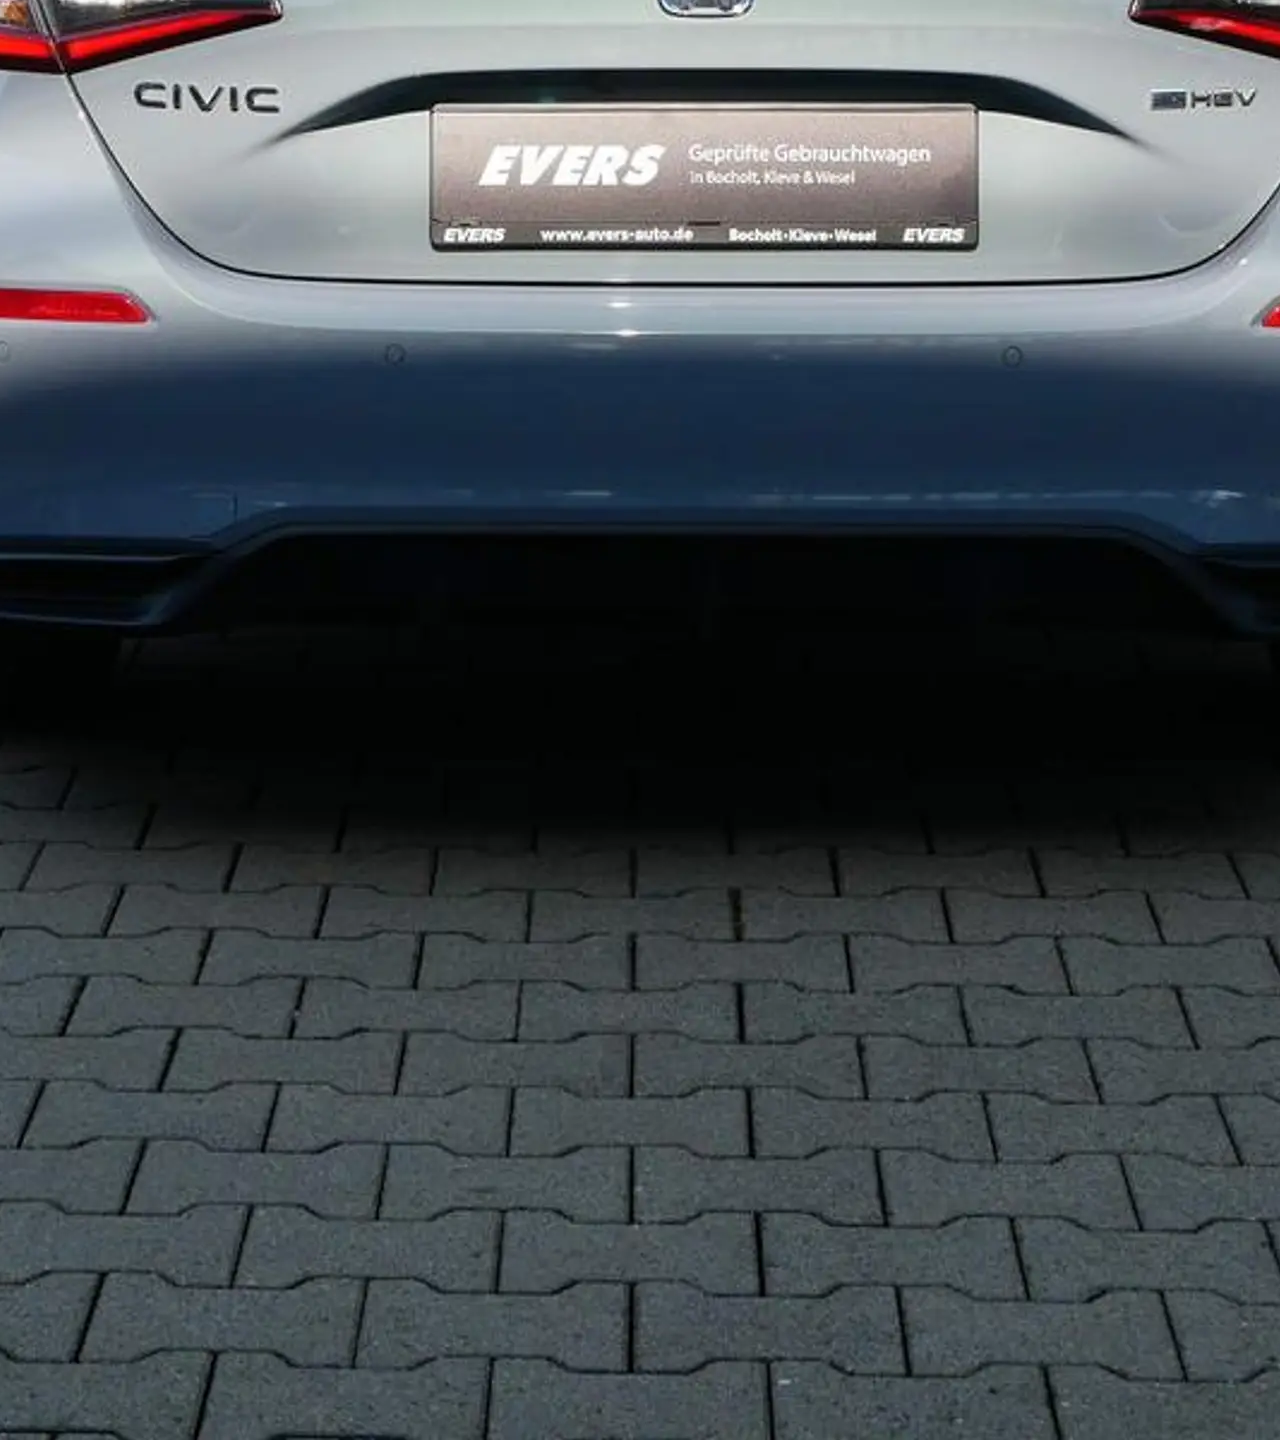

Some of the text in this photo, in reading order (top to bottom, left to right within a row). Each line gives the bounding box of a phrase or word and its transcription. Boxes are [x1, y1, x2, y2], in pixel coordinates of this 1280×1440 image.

[133, 81, 280, 114] CIVIC
[688, 143, 931, 166] Geprüfte Gebrauchtwagen
[478, 144, 667, 187] EVERS
[803, 171, 814, 184] &
[816, 170, 855, 185] Wesel
[443, 227, 506, 243] EVERS
[539, 226, 694, 242] www.evers-auto.de
[903, 227, 965, 243] EVERS
